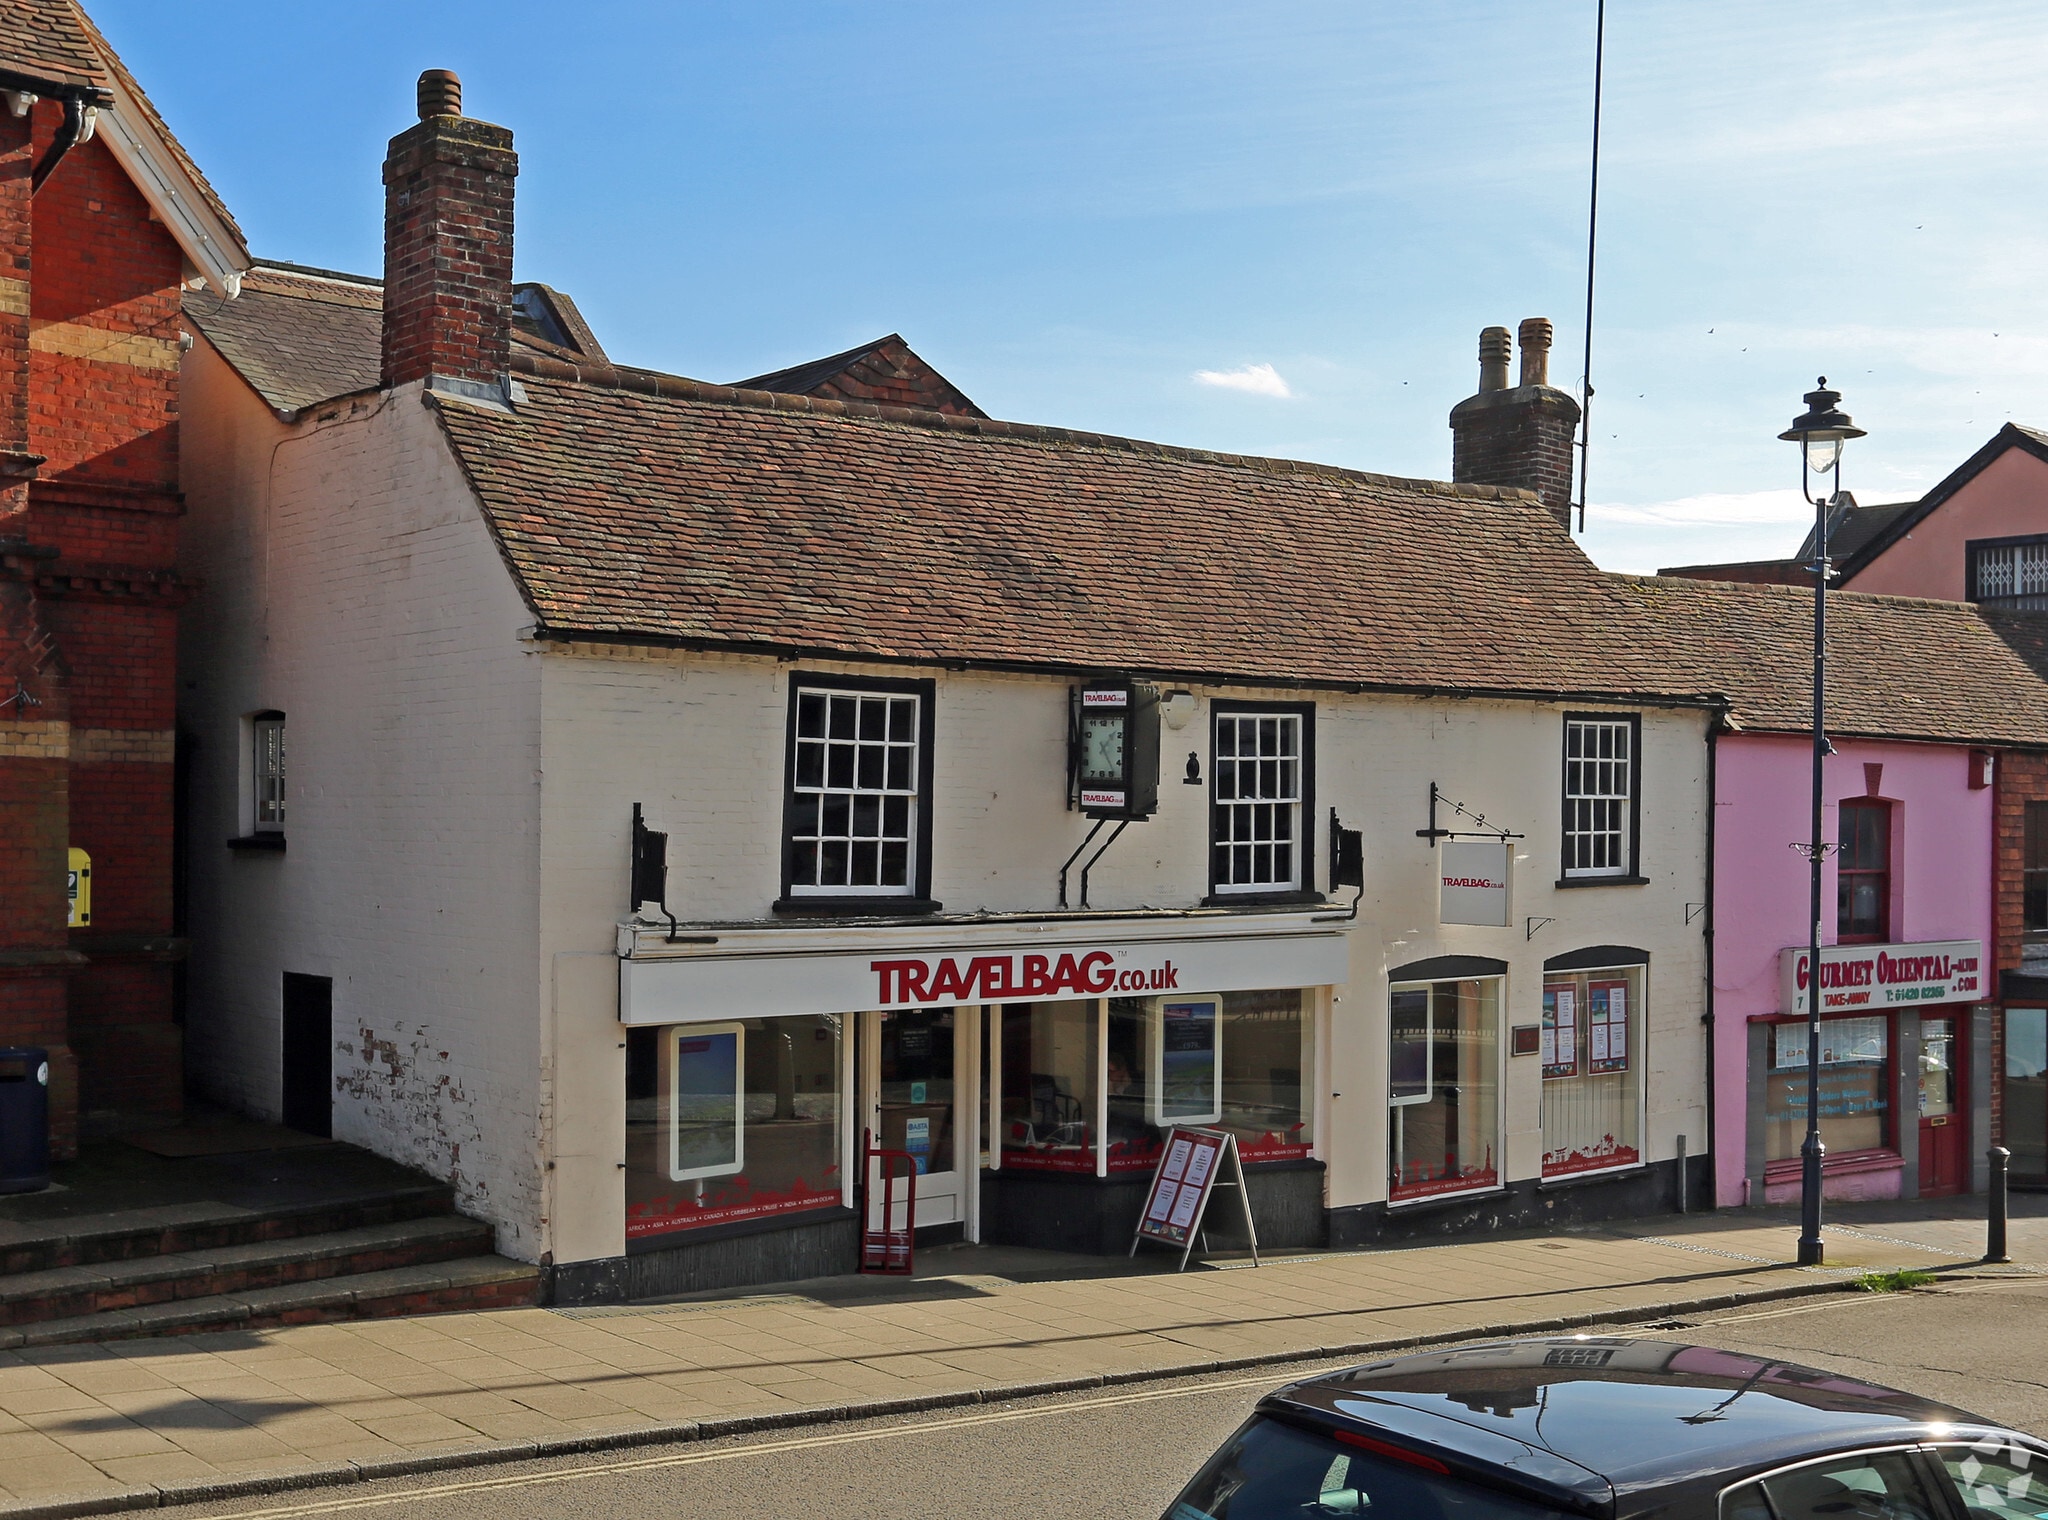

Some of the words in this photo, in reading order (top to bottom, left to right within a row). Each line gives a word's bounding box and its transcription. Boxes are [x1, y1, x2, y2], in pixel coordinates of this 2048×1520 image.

[1442, 877, 1504, 889] TRAVELBAG.co.uk
[1796, 955, 1874, 991] GURMET
[1824, 991, 1871, 1006] TAKE-AWAY
